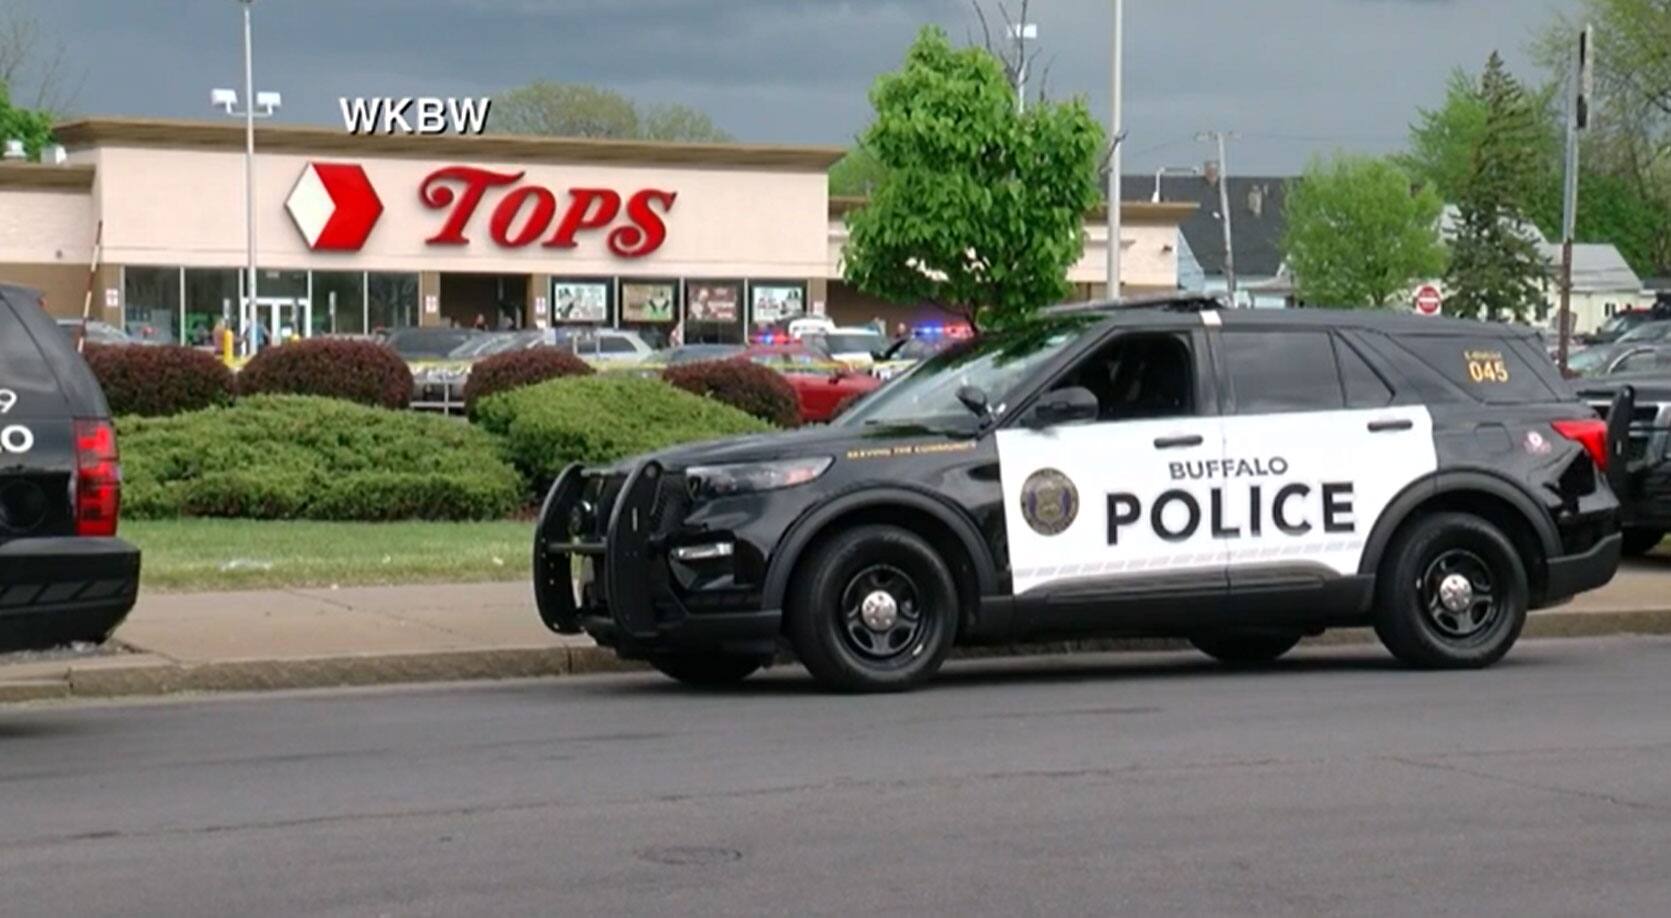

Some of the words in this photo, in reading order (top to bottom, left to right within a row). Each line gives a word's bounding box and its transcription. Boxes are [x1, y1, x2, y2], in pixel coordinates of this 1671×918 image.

[1468, 360, 1509, 382] 045
[1168, 456, 1289, 480] BUFFALO
[1105, 481, 1357, 545] POLICE
